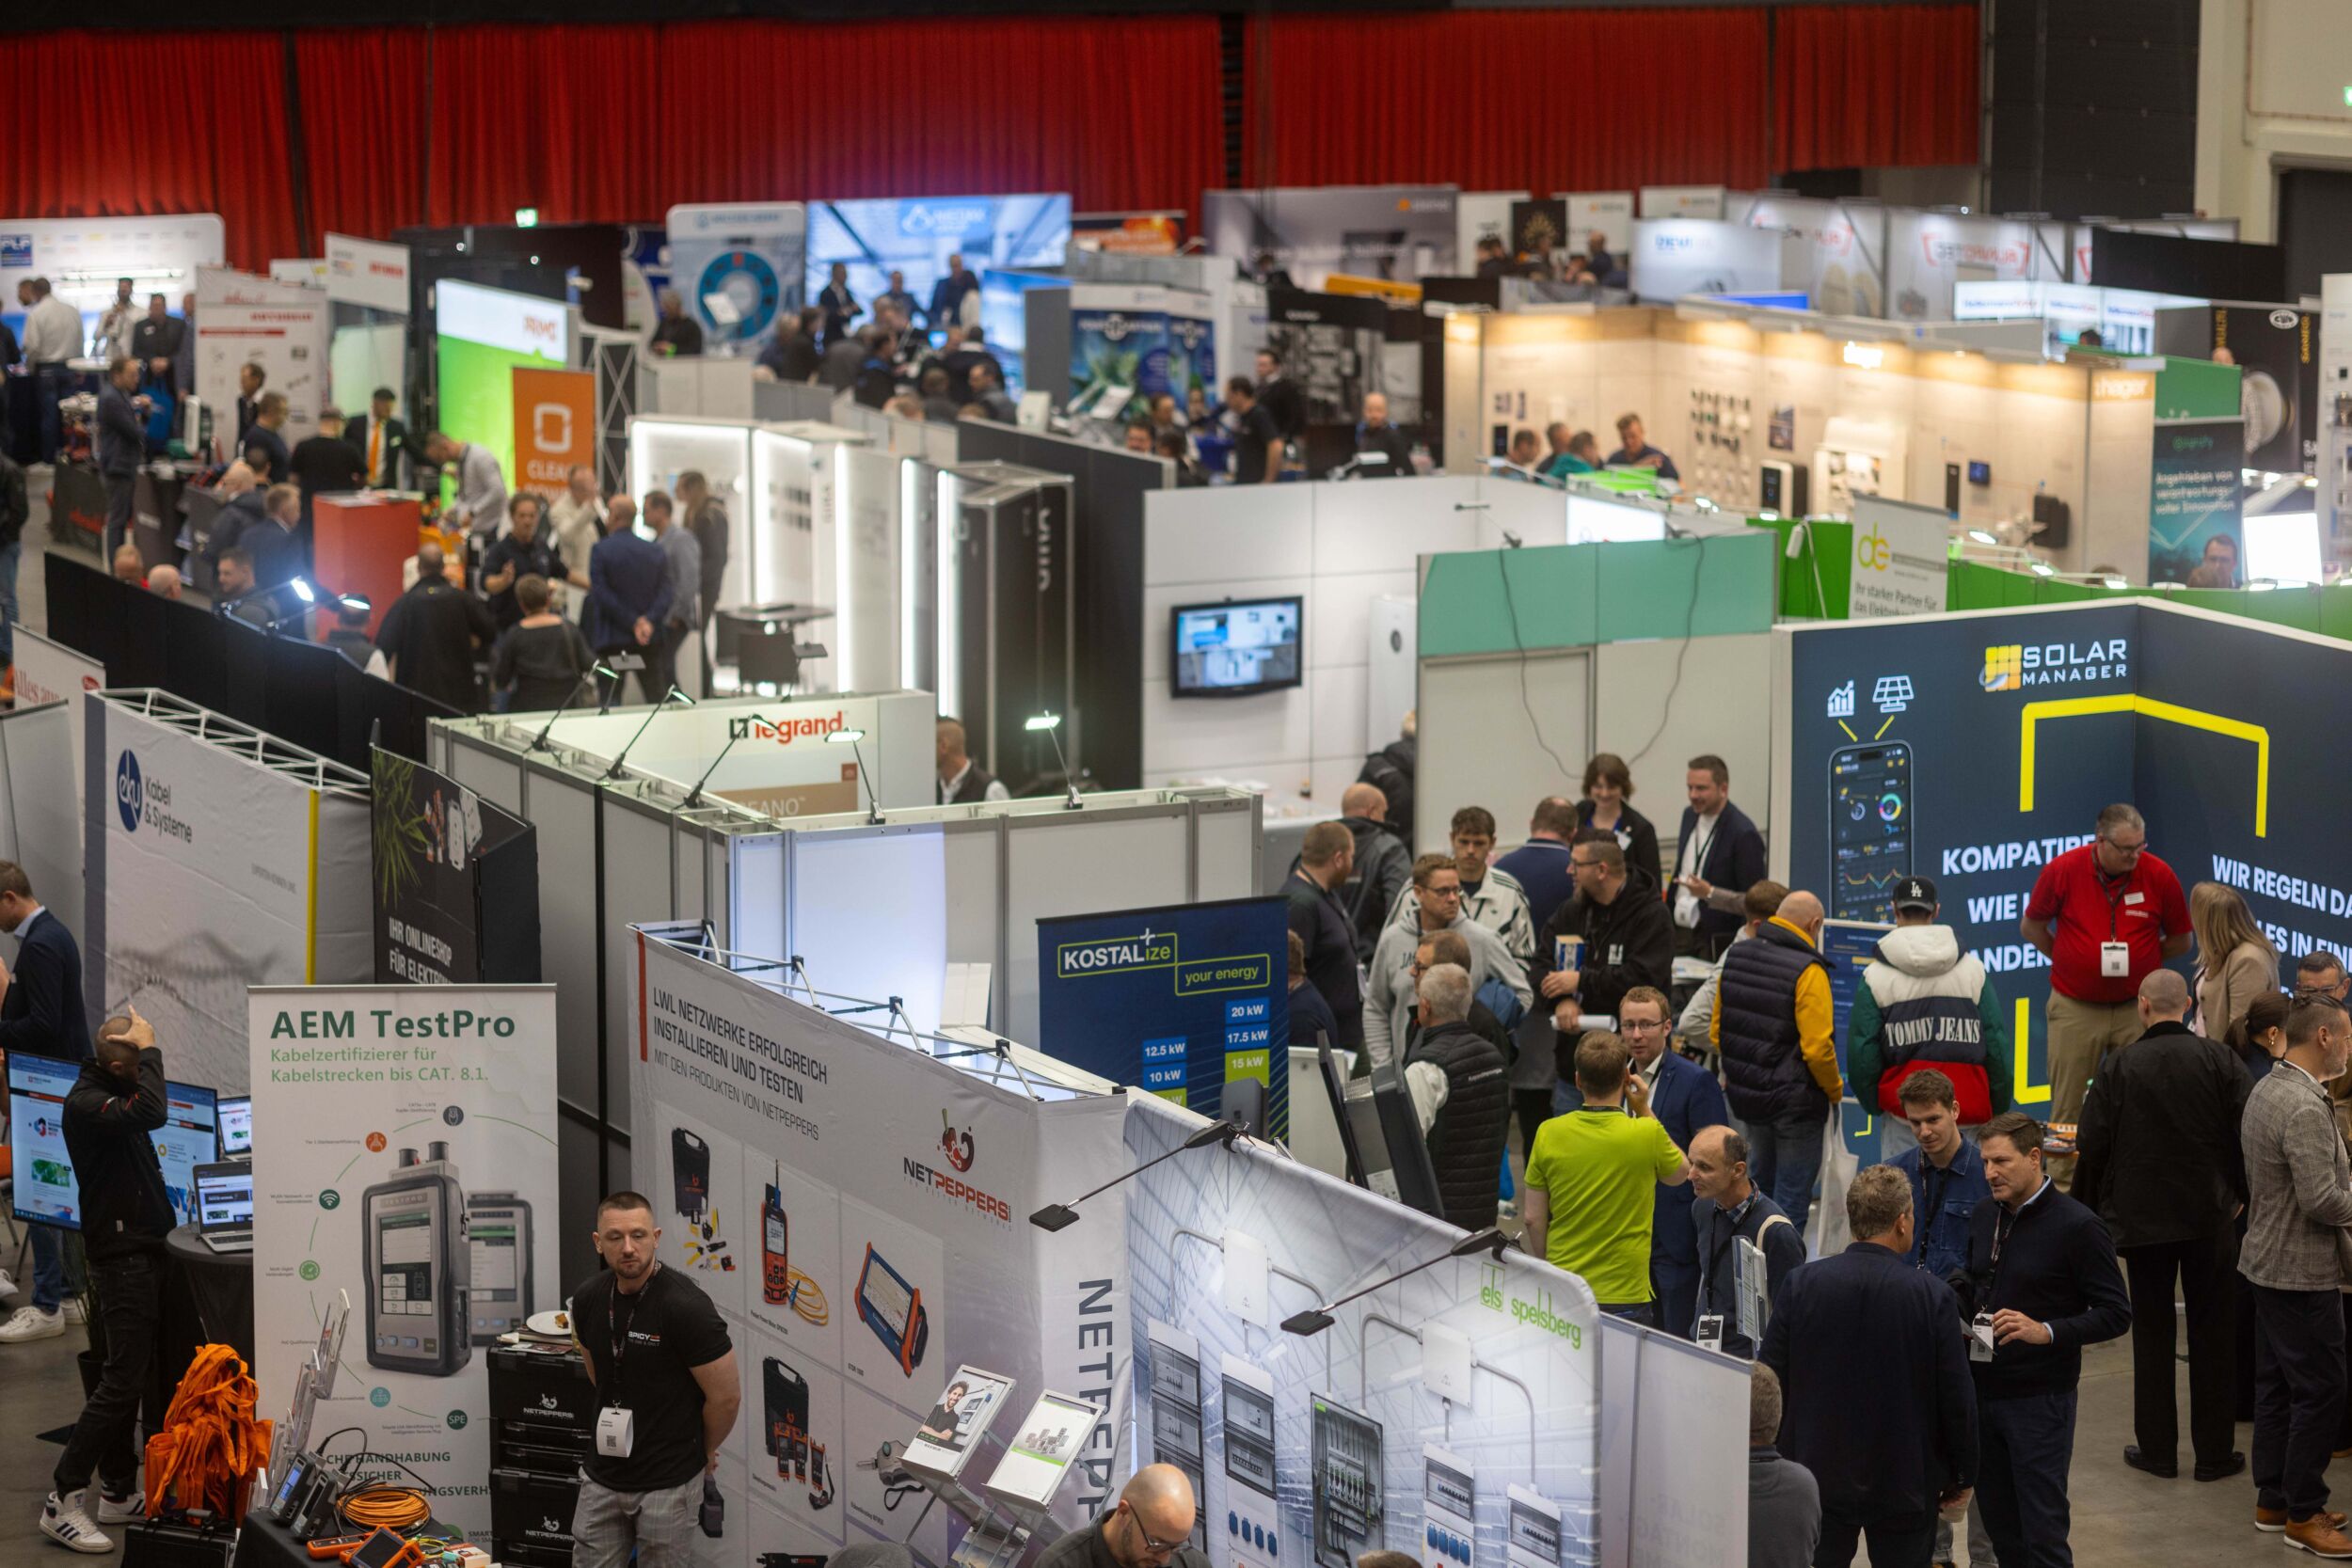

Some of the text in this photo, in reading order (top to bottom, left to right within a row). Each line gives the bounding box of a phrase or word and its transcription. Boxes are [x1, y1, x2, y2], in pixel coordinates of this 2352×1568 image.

[527, 459, 569, 482] CLEA
[2215, 469, 2234, 482] von
[2024, 639, 2127, 668] SOLAR
[2024, 663, 2127, 686] MANAGER
[755, 710, 843, 744] legrand
[145, 775, 171, 806] Kabel
[145, 803, 193, 844] & Systeme
[2212, 854, 2250, 889] WIR
[2253, 866, 2327, 911] REGELN
[1967, 893, 2018, 924] WIE
[389, 916, 453, 968] IHR ONLINESHOP
[2291, 930, 2312, 958] IN
[389, 946, 407, 978] FÜR
[1064, 944, 1171, 971] KOSTALize
[1399, 951, 1415, 970] JA
[1184, 966, 1259, 987] your energy
[270, 1009, 516, 1038] AEM TestPro
[1231, 1004, 1264, 1017] 20 kW
[653, 986, 828, 1085] LWL NETZWERKE ERFOLGREICH
[1227, 1030, 1268, 1043] 17.5 kW
[1884, 1016, 1980, 1047] TOMMY JEANS
[270, 1046, 437, 1062] Kabelzertifizierer für
[653, 1016, 803, 1104] INSTALLIEREN UND TESTEN
[1145, 1041, 1185, 1057] 12.5 kW
[1232, 1055, 1263, 1069] 15 kW
[270, 1066, 489, 1083] Kabelstrecken bis CAT. 8.1.
[1149, 1069, 1182, 1084] 10 kW
[653, 1047, 819, 1141] MIT DEN PRODUKTEN VON NETPEPPERS
[903, 1156, 1009, 1222] NETPEPPERS
[1481, 1267, 1581, 1350] els spelsberg
[448, 1415, 466, 1424] SPE
[523, 1407, 575, 1418] NETPEPPERS
[356, 1451, 452, 1465] HANDHABUNG
